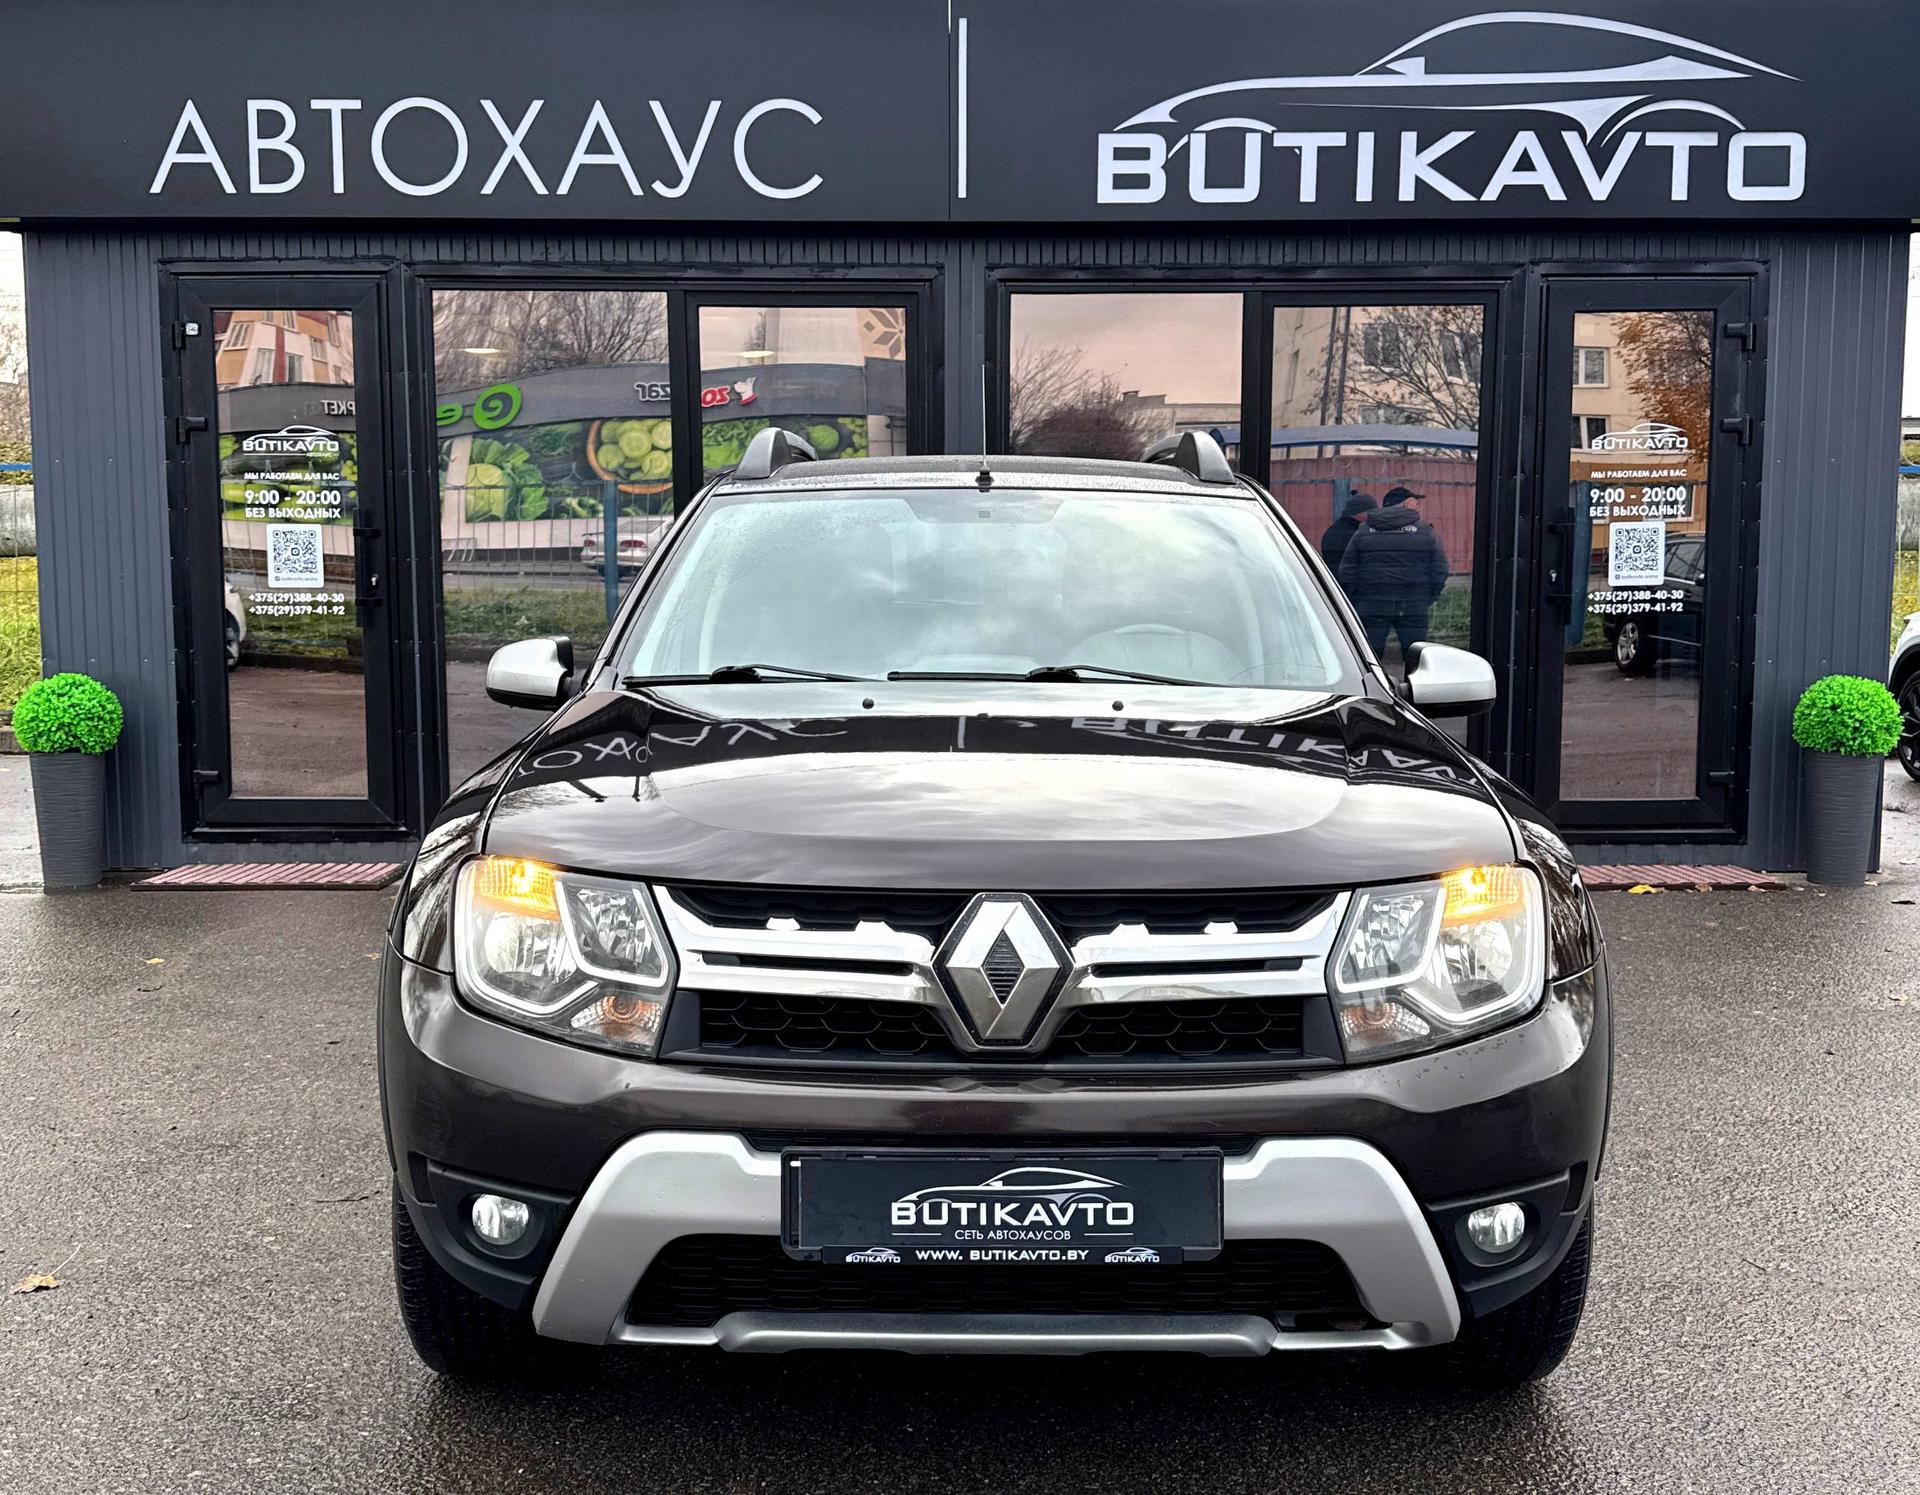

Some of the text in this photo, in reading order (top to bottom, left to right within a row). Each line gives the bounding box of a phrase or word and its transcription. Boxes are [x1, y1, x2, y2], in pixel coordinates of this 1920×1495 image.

[149, 96, 824, 199] АВТОХАУС
[1097, 130, 1807, 204] BUTIKAVTO
[242, 439, 340, 452] BUTIKAVTO
[1591, 436, 1689, 450] BUTIKAVTO
[243, 472, 340, 481] МЫ РАБОТАЕМ ДЛЯ ВАС
[1590, 468, 1687, 479] МЫ РАБОТАЕМ ДЛЯ ВАС
[244, 489, 280, 505] 9:00
[295, 489, 341, 505] 20:00
[1590, 487, 1625, 503] 9:00
[1641, 487, 1687, 502] 20:00
[245, 507, 341, 519] БЕЗ ВЫХОДНЫХ
[1589, 503, 1686, 517] БЕЗ ВЫХОДНЫХ
[248, 592, 345, 604] +375(29)388-40-30
[1587, 589, 1684, 602] +375(29)388-40-30
[249, 605, 345, 617] +375(29)379-41-92
[1587, 602, 1683, 615] +375(29)379-41-92
[891, 1201, 1134, 1226] BUTIKAVTO
[954, 1229, 1071, 1241] СЕТЬ АВТОХАУСОВ
[845, 1254, 901, 1264] BUTIKAVTO
[915, 1249, 1089, 1261] WWW. BUTIKAVTO.BY
[1104, 1254, 1160, 1264] BUTIKAVTO
